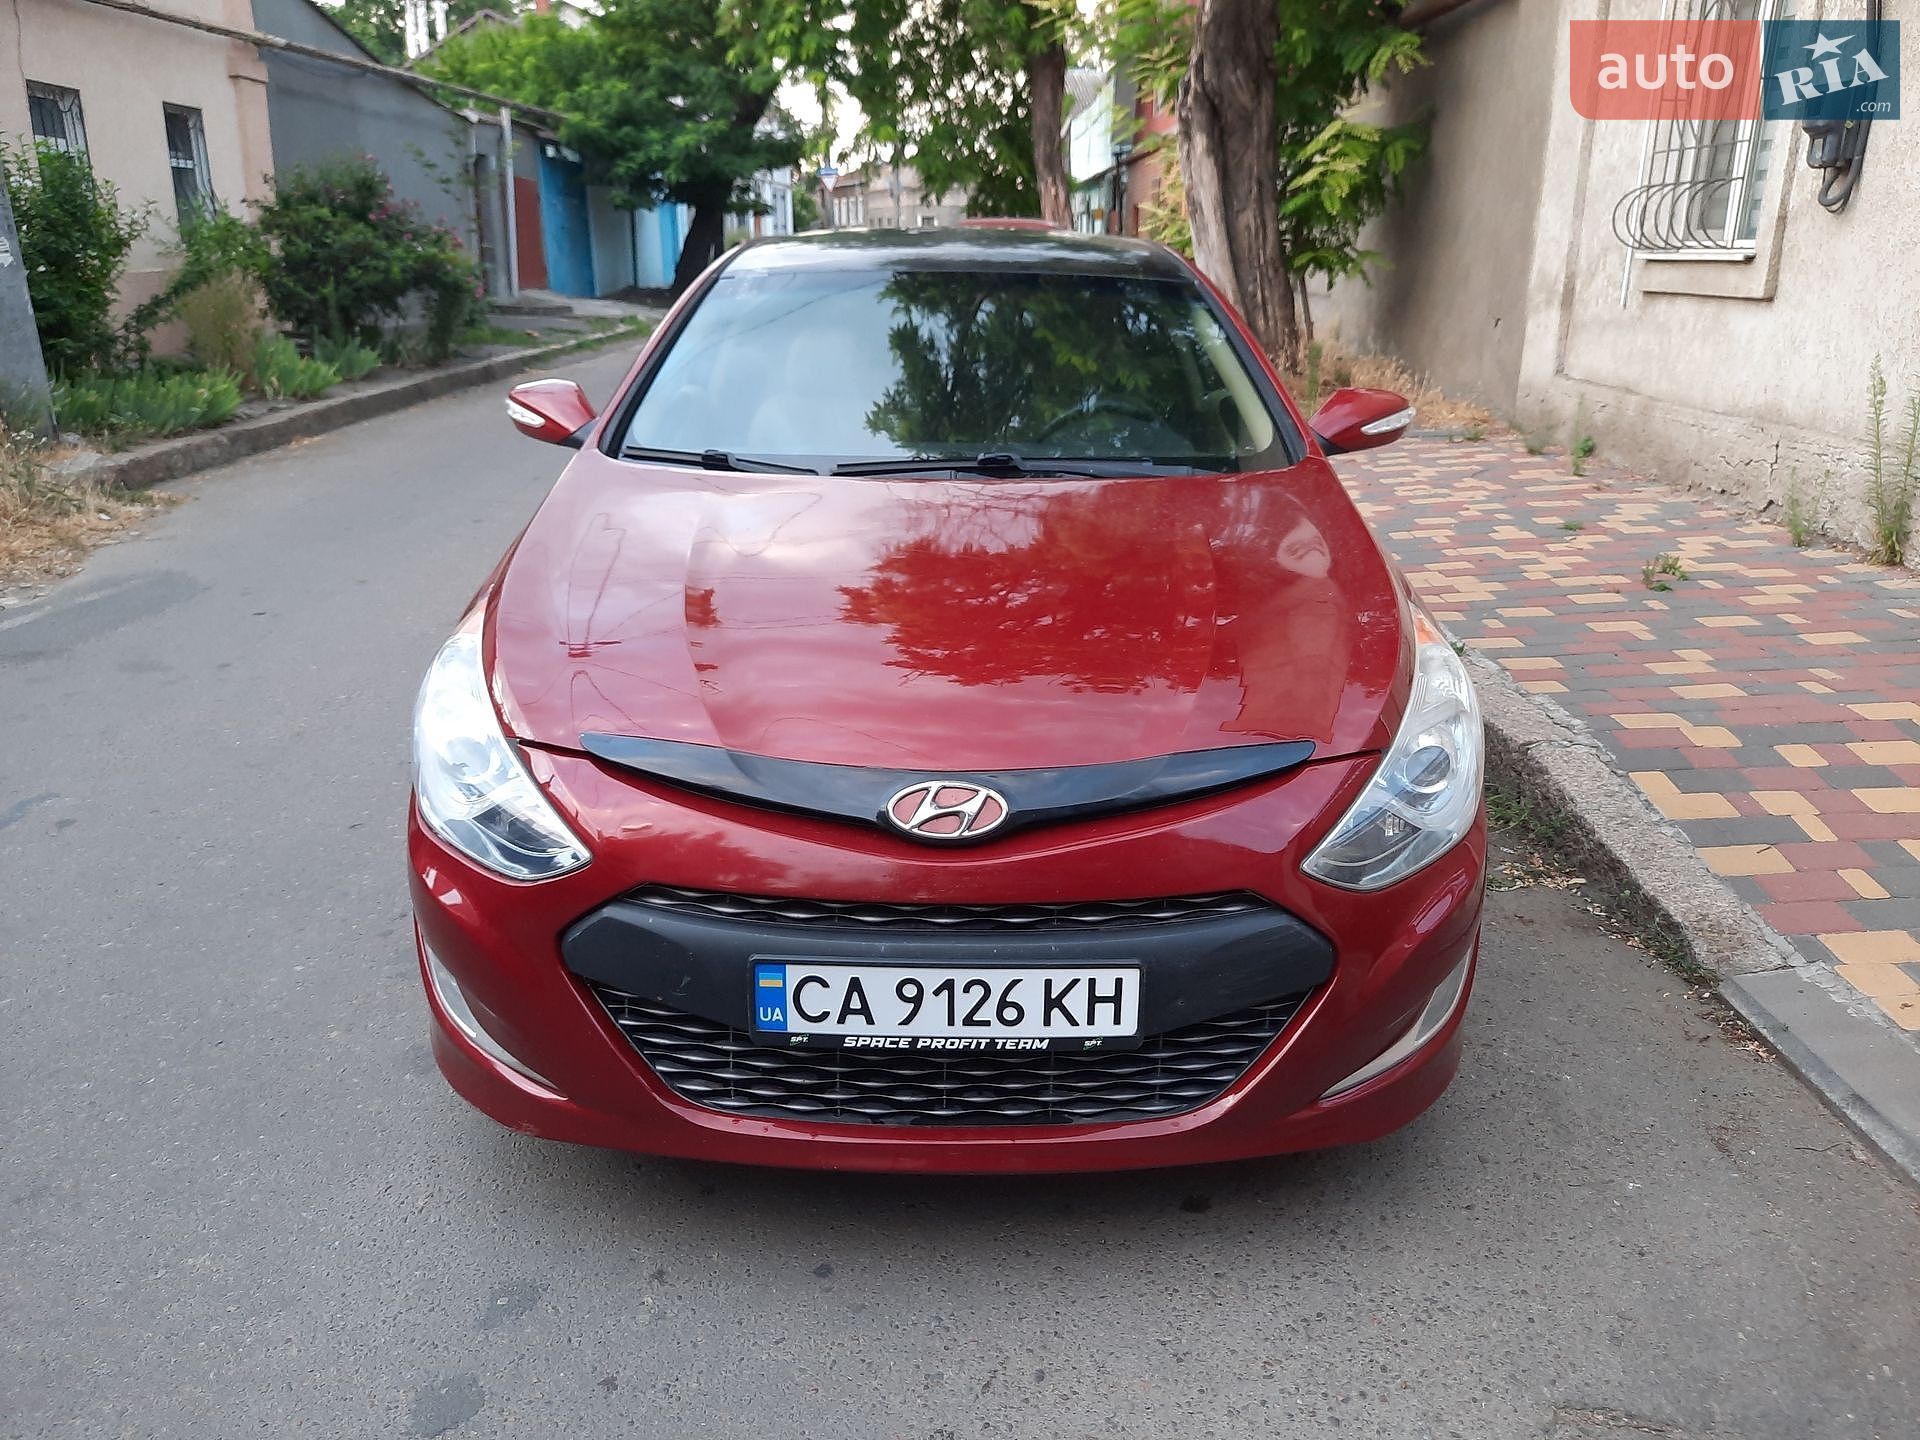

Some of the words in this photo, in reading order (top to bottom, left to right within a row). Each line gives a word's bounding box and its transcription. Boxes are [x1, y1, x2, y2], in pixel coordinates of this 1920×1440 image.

[792, 975, 875, 1025] CA
[895, 977, 1025, 1027] 9126
[1043, 977, 1123, 1026] KH
[760, 1007, 783, 1022] UA
[843, 1036, 912, 1048] SPACE
[917, 1038, 989, 1050] PROFIT
[995, 1039, 1049, 1050] TEAM
